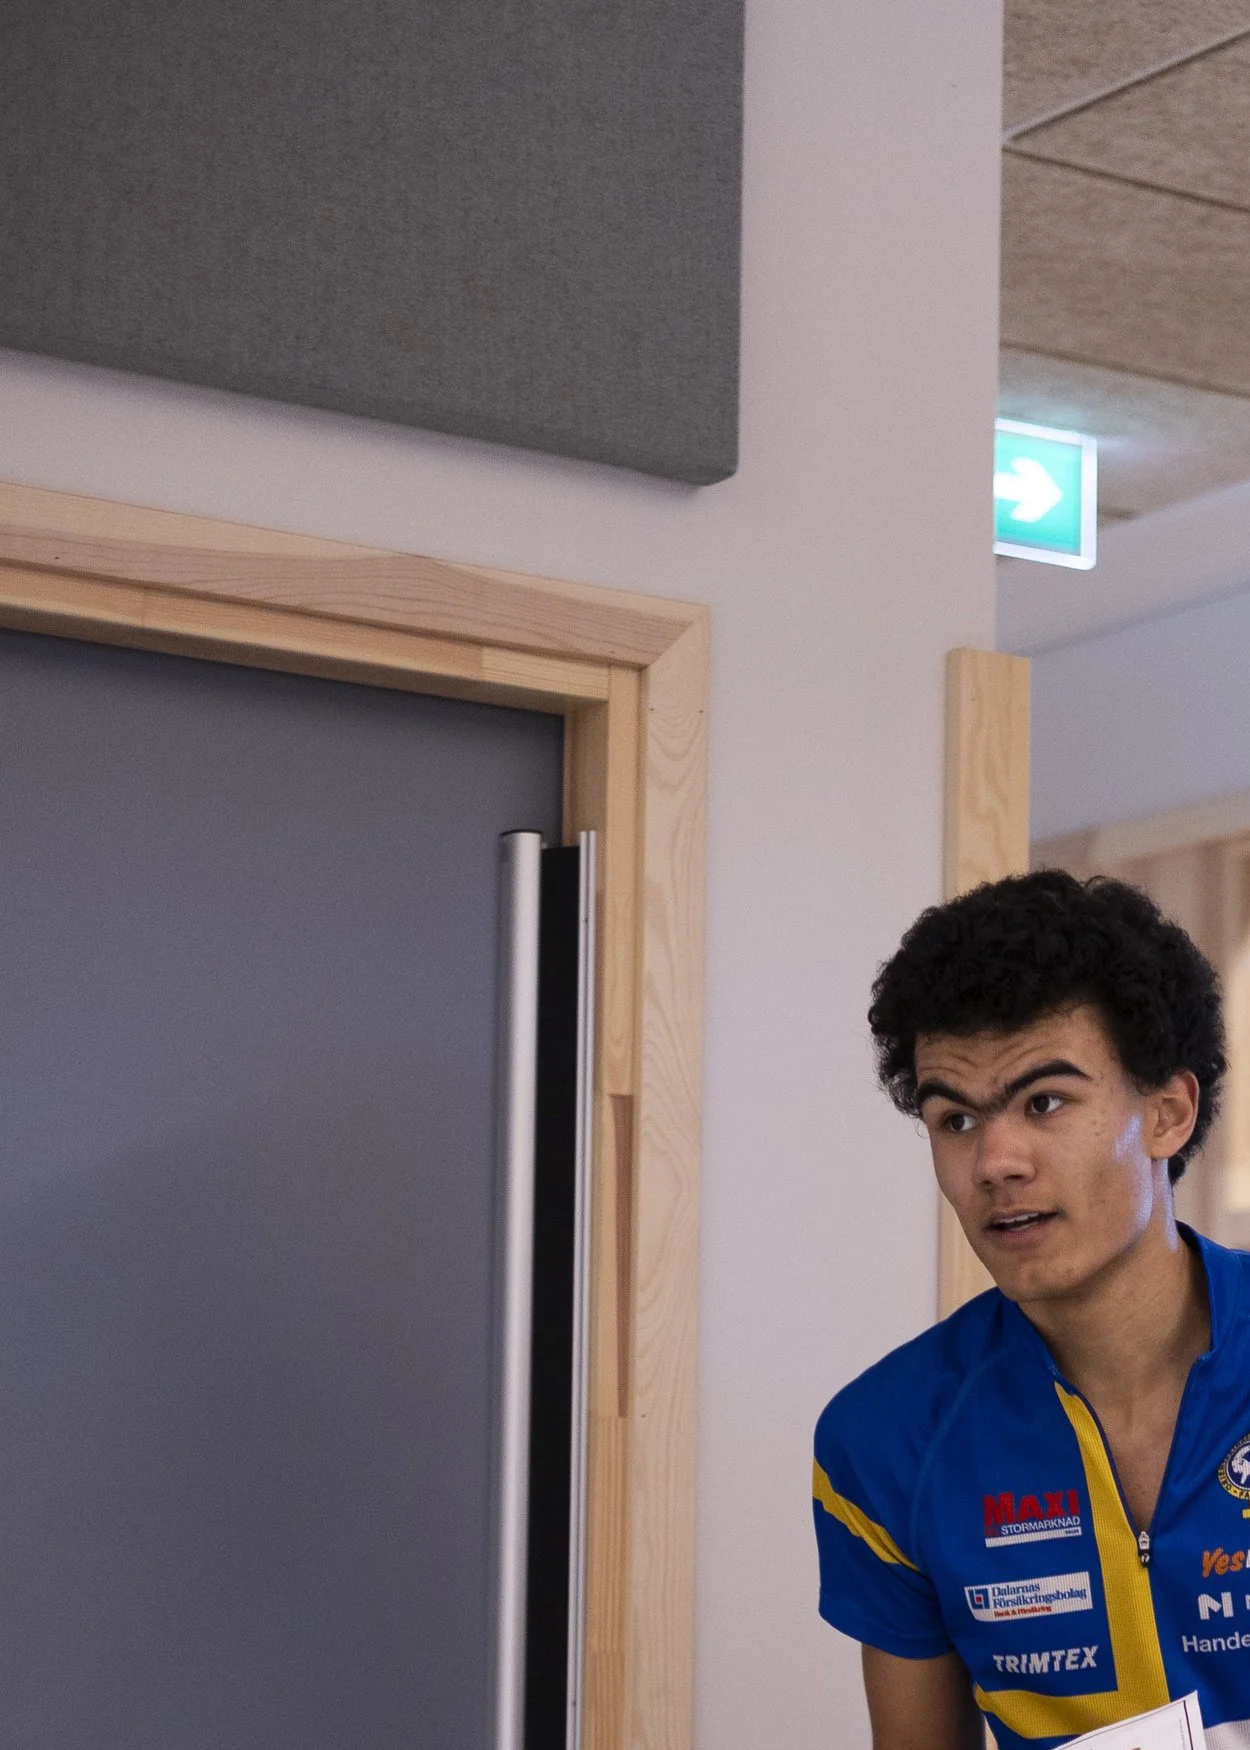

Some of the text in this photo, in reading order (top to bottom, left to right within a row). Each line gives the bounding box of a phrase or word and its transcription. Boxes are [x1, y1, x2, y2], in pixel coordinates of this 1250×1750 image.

[983, 1489, 1080, 1529] MAXI
[1001, 1516, 1081, 1536] STORMARKNAD
[992, 1583, 1041, 1597] Dalarnas
[993, 1588, 1087, 1609] Försäkringsbolag
[992, 1645, 1099, 1675] TRIMTEX
